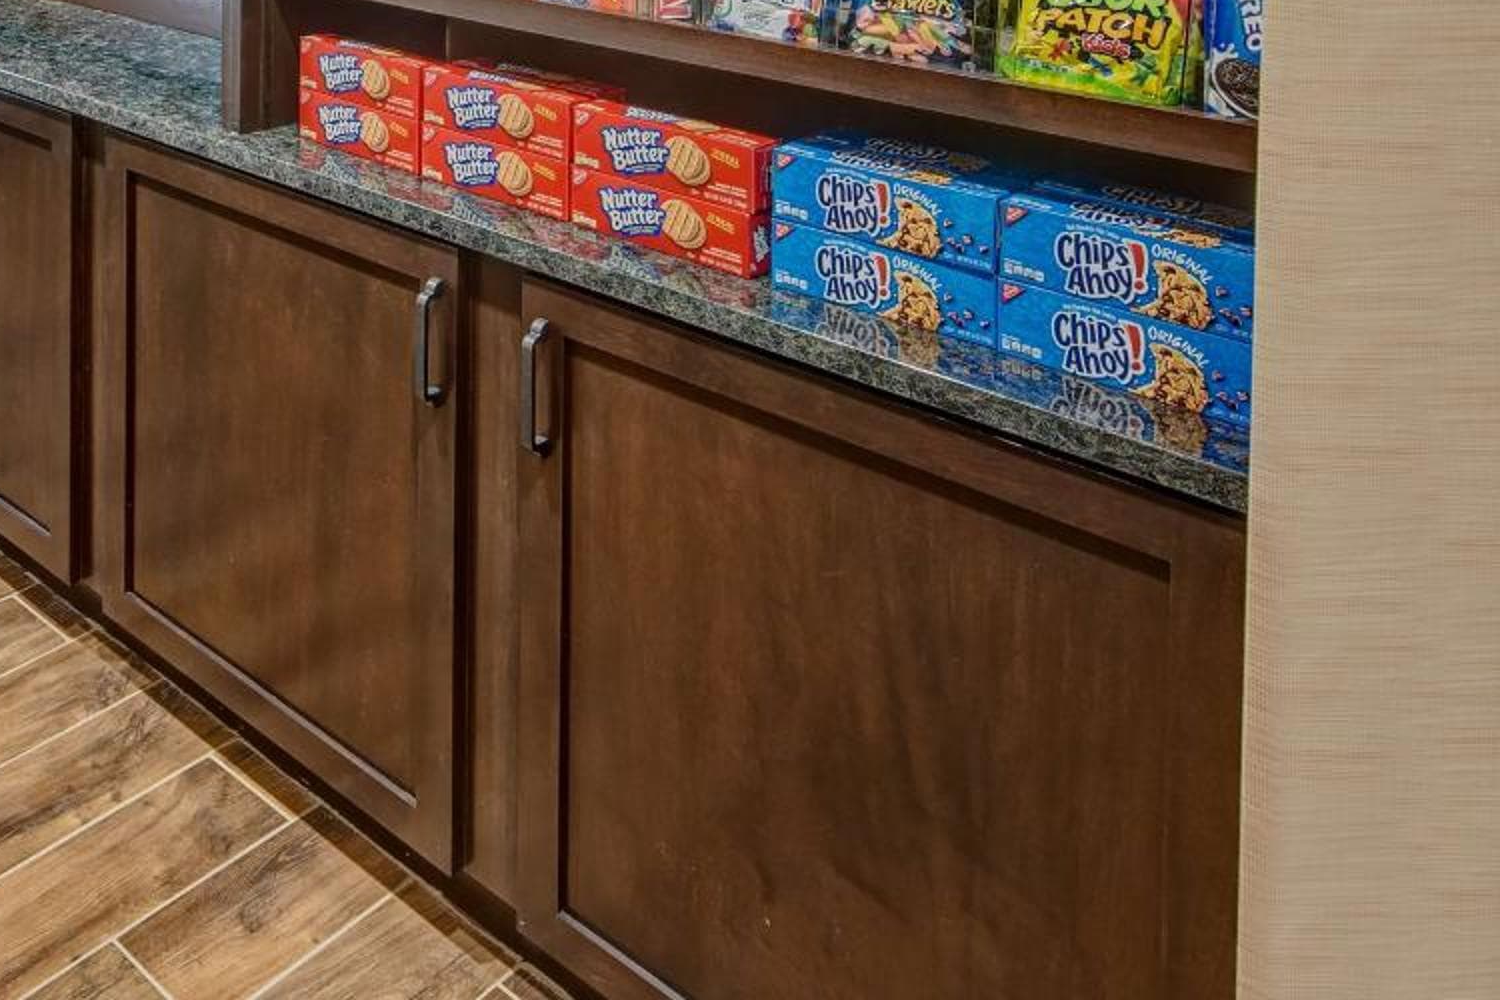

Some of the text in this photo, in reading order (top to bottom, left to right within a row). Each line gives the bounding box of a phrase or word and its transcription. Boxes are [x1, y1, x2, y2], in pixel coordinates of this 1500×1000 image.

[1035, 7, 1171, 50] PATCH
[446, 87, 494, 107] Nutter
[455, 103, 500, 126] Butter
[602, 127, 660, 149] Nutter
[445, 142, 492, 165] Nutter
[612, 145, 669, 172] Butter
[453, 160, 498, 182] Butter
[600, 187, 657, 212] Nutter
[818, 175, 876, 208] Chips
[609, 207, 666, 231] Butter
[817, 247, 875, 278] Chips
[1057, 233, 1130, 267] Chips
[1053, 313, 1126, 348] Chips
